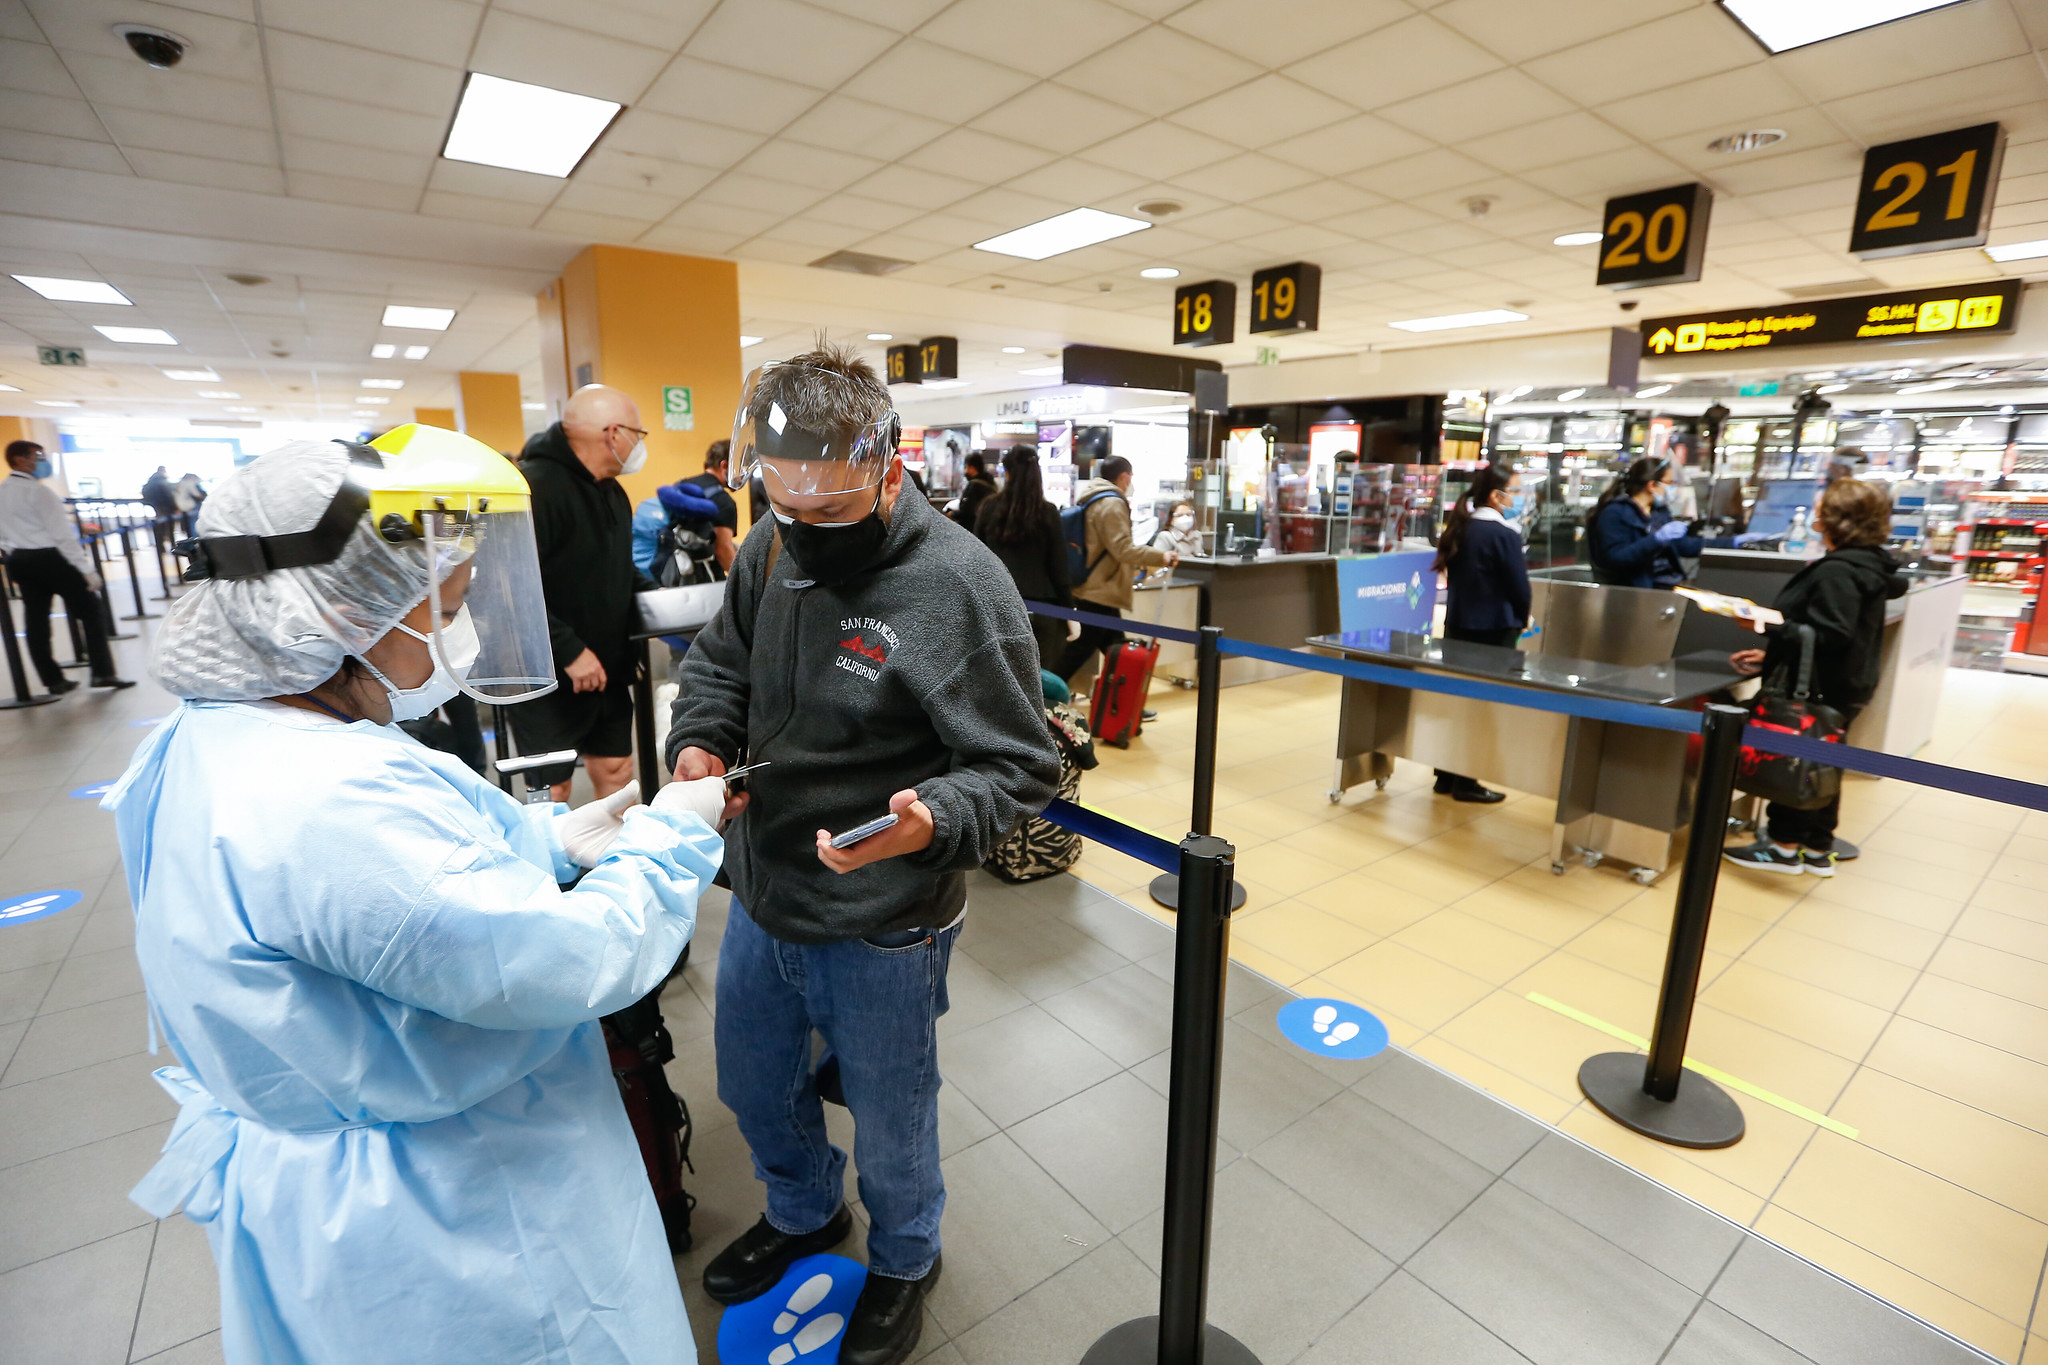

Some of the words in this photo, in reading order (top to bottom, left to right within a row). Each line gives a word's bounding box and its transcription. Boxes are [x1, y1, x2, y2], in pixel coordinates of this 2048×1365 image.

[1864, 149, 1978, 232] 21
[1602, 203, 1687, 269] 20
[1177, 292, 1213, 334] 18
[1254, 277, 1296, 322] 19
[888, 352, 905, 379] 16
[920, 344, 939, 373] 17
[667, 389, 689, 412] S
[1357, 582, 1407, 598] MIGRACIONES
[840, 617, 862, 631] SAN
[863, 617, 901, 651] FRANCISCO
